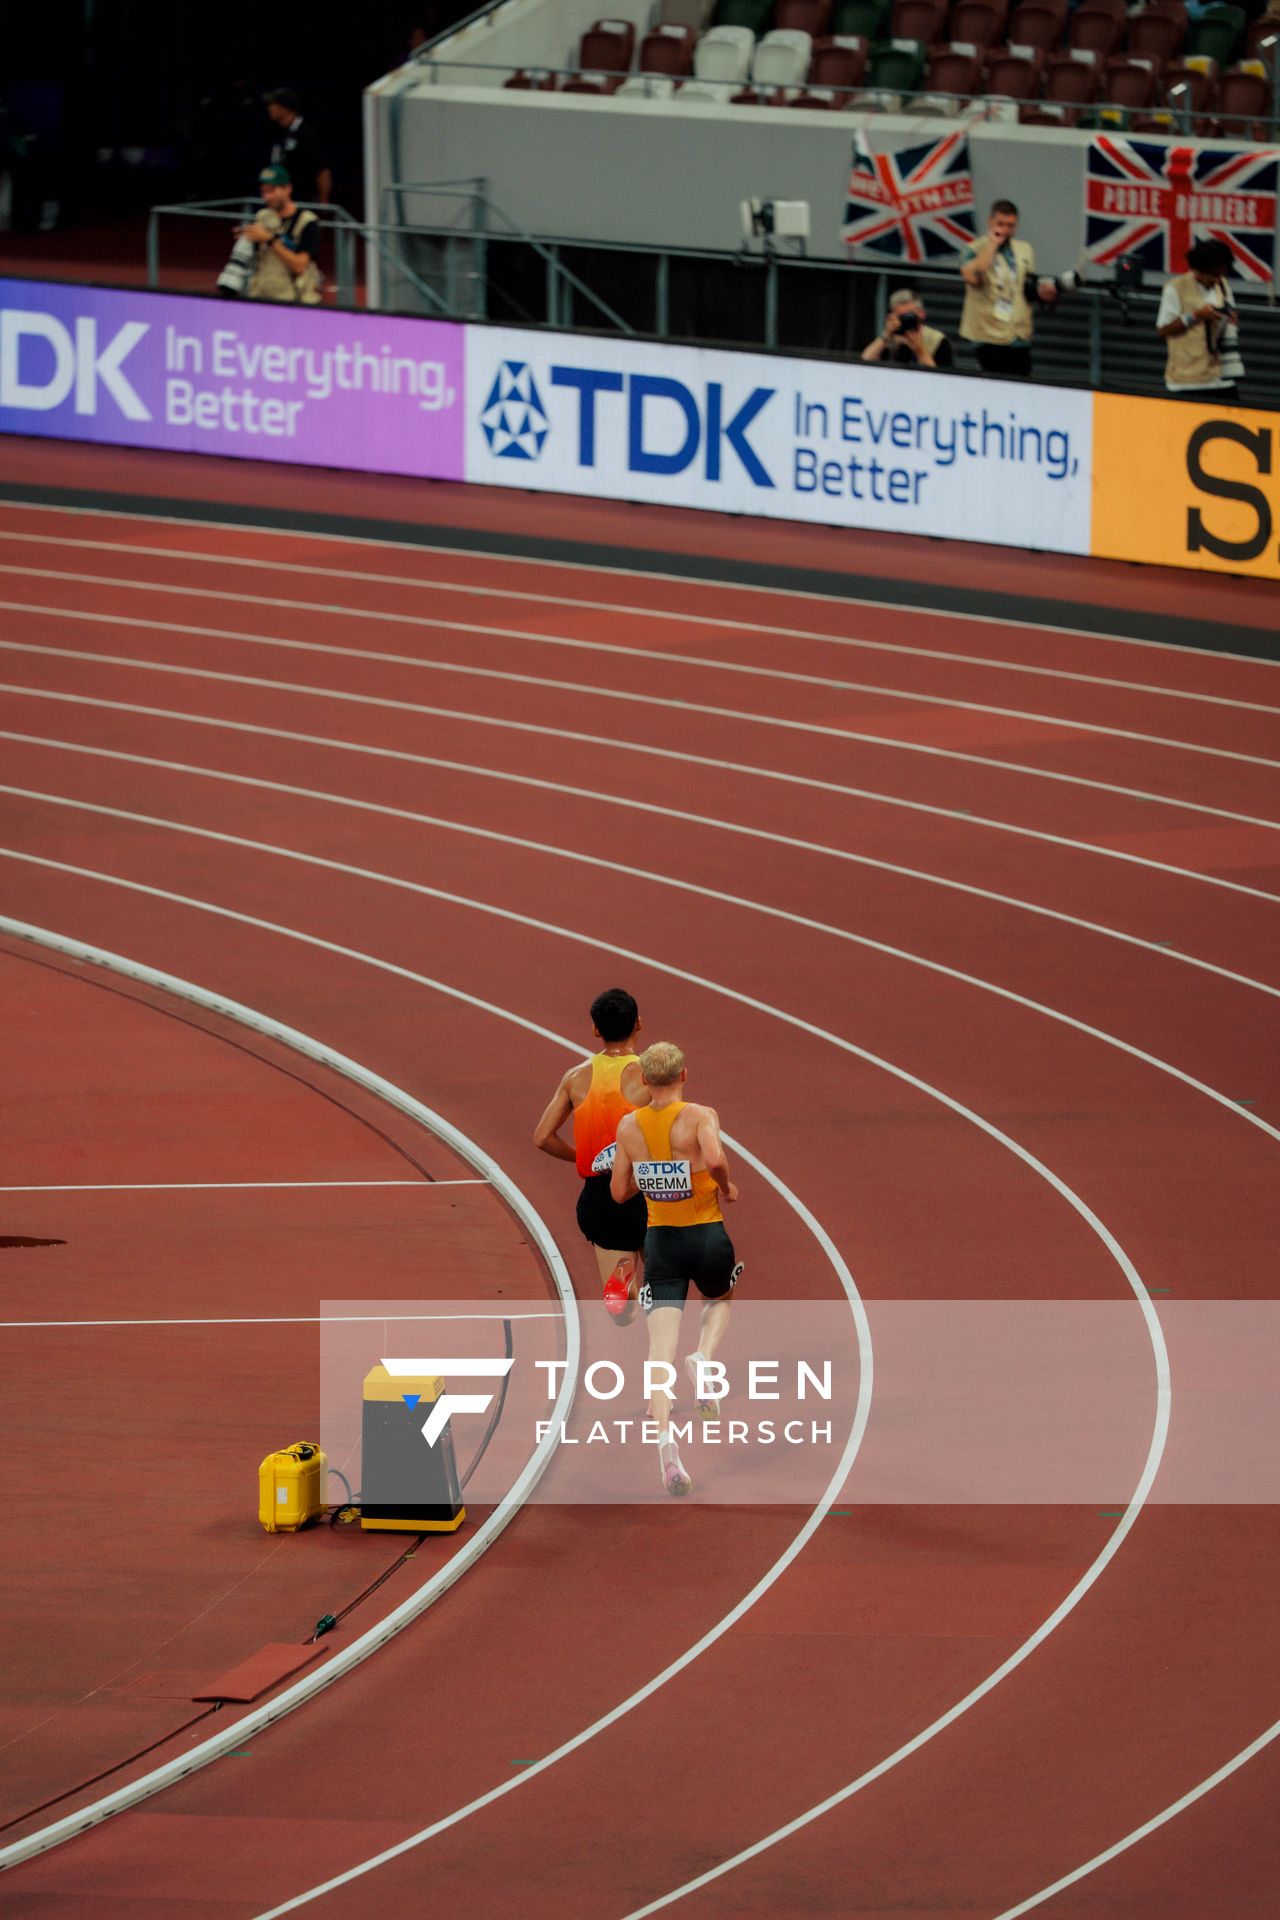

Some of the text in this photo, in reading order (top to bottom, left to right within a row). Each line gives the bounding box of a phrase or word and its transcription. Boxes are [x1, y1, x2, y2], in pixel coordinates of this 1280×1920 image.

[164, 326, 456, 411] In Everything,
[165, 379, 304, 436] Better
[550, 365, 777, 488] TDK
[796, 391, 1079, 479] In Everything,
[794, 448, 929, 504] Better
[1186, 419, 1280, 562] S
[639, 1177, 688, 1190] BREMM
[649, 1162, 685, 1174] TDK
